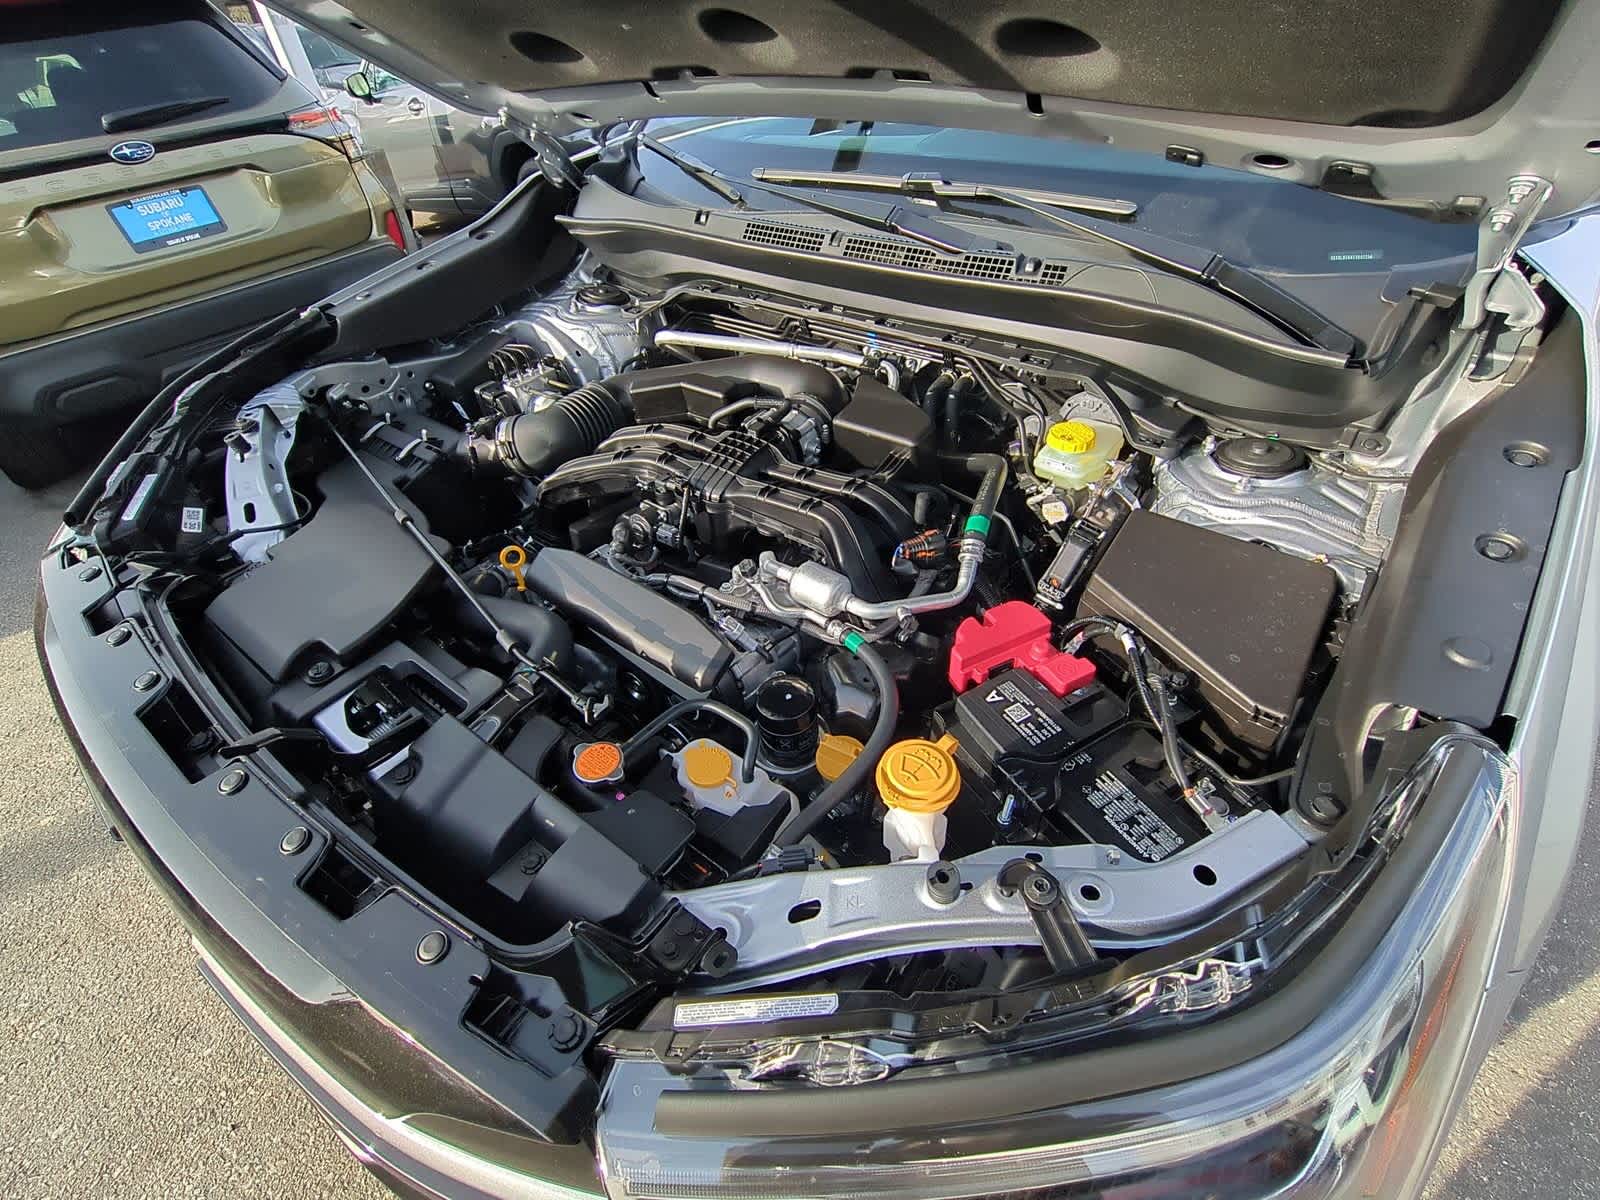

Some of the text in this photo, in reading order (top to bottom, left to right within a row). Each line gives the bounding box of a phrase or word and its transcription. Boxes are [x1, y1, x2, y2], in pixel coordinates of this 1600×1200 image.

[137, 196, 184, 216] SUBARU
[147, 212, 194, 231] SPOKANE
[985, 689, 1005, 703] A
